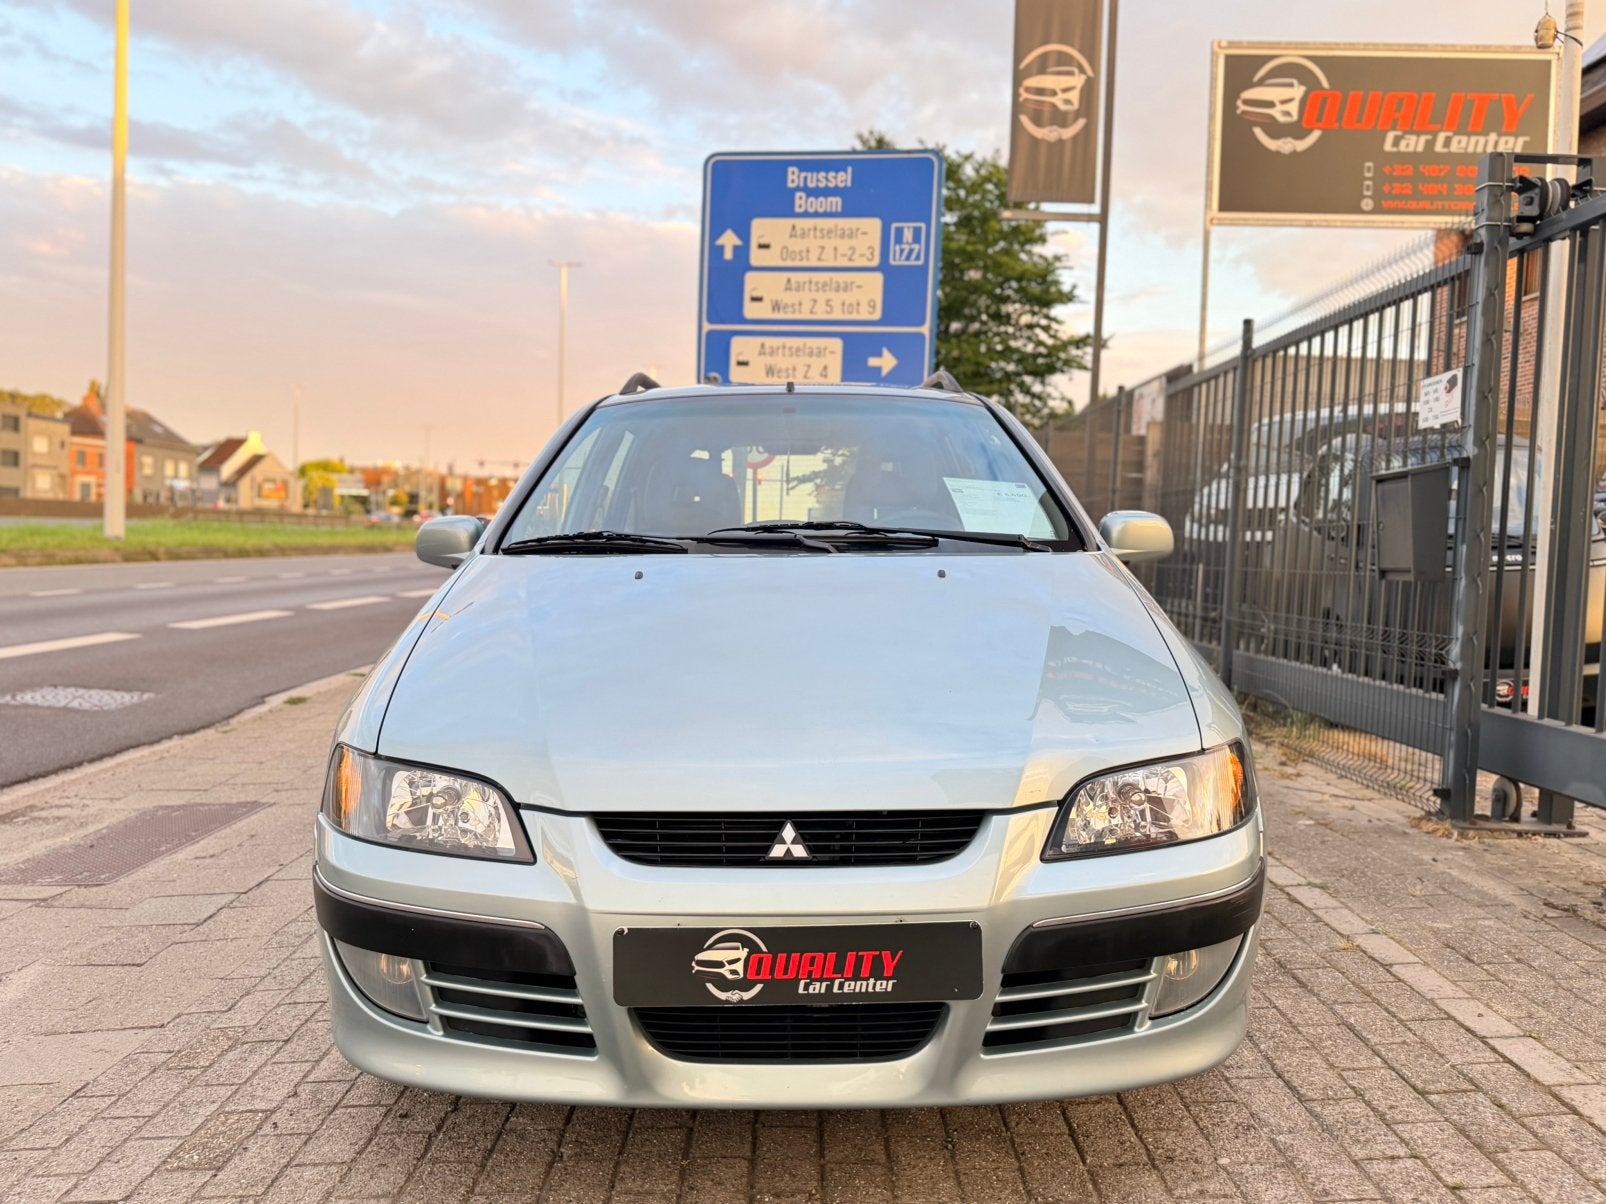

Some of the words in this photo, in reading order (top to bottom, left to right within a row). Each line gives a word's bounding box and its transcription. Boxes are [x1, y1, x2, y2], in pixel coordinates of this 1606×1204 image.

[1302, 90, 1535, 133] QUALITY
[1383, 130, 1432, 153] Car
[1433, 131, 1531, 153] Center
[787, 166, 852, 188] Brussel
[794, 191, 842, 213] Boom
[788, 224, 869, 240] Aartselaar-
[903, 227, 913, 243] N
[779, 246, 811, 262] Oost
[833, 246, 876, 262] 1-2-3
[895, 244, 920, 261] 177
[783, 278, 863, 293] Aartselaar-
[770, 299, 803, 315] West
[841, 300, 861, 315] tot
[867, 299, 877, 315] 9
[757, 342, 836, 358] Aartselaar-
[764, 364, 797, 379] West
[819, 364, 829, 379] 4
[746, 950, 903, 980] QUALITY
[797, 979, 831, 994] Car
[832, 977, 898, 993] Center
